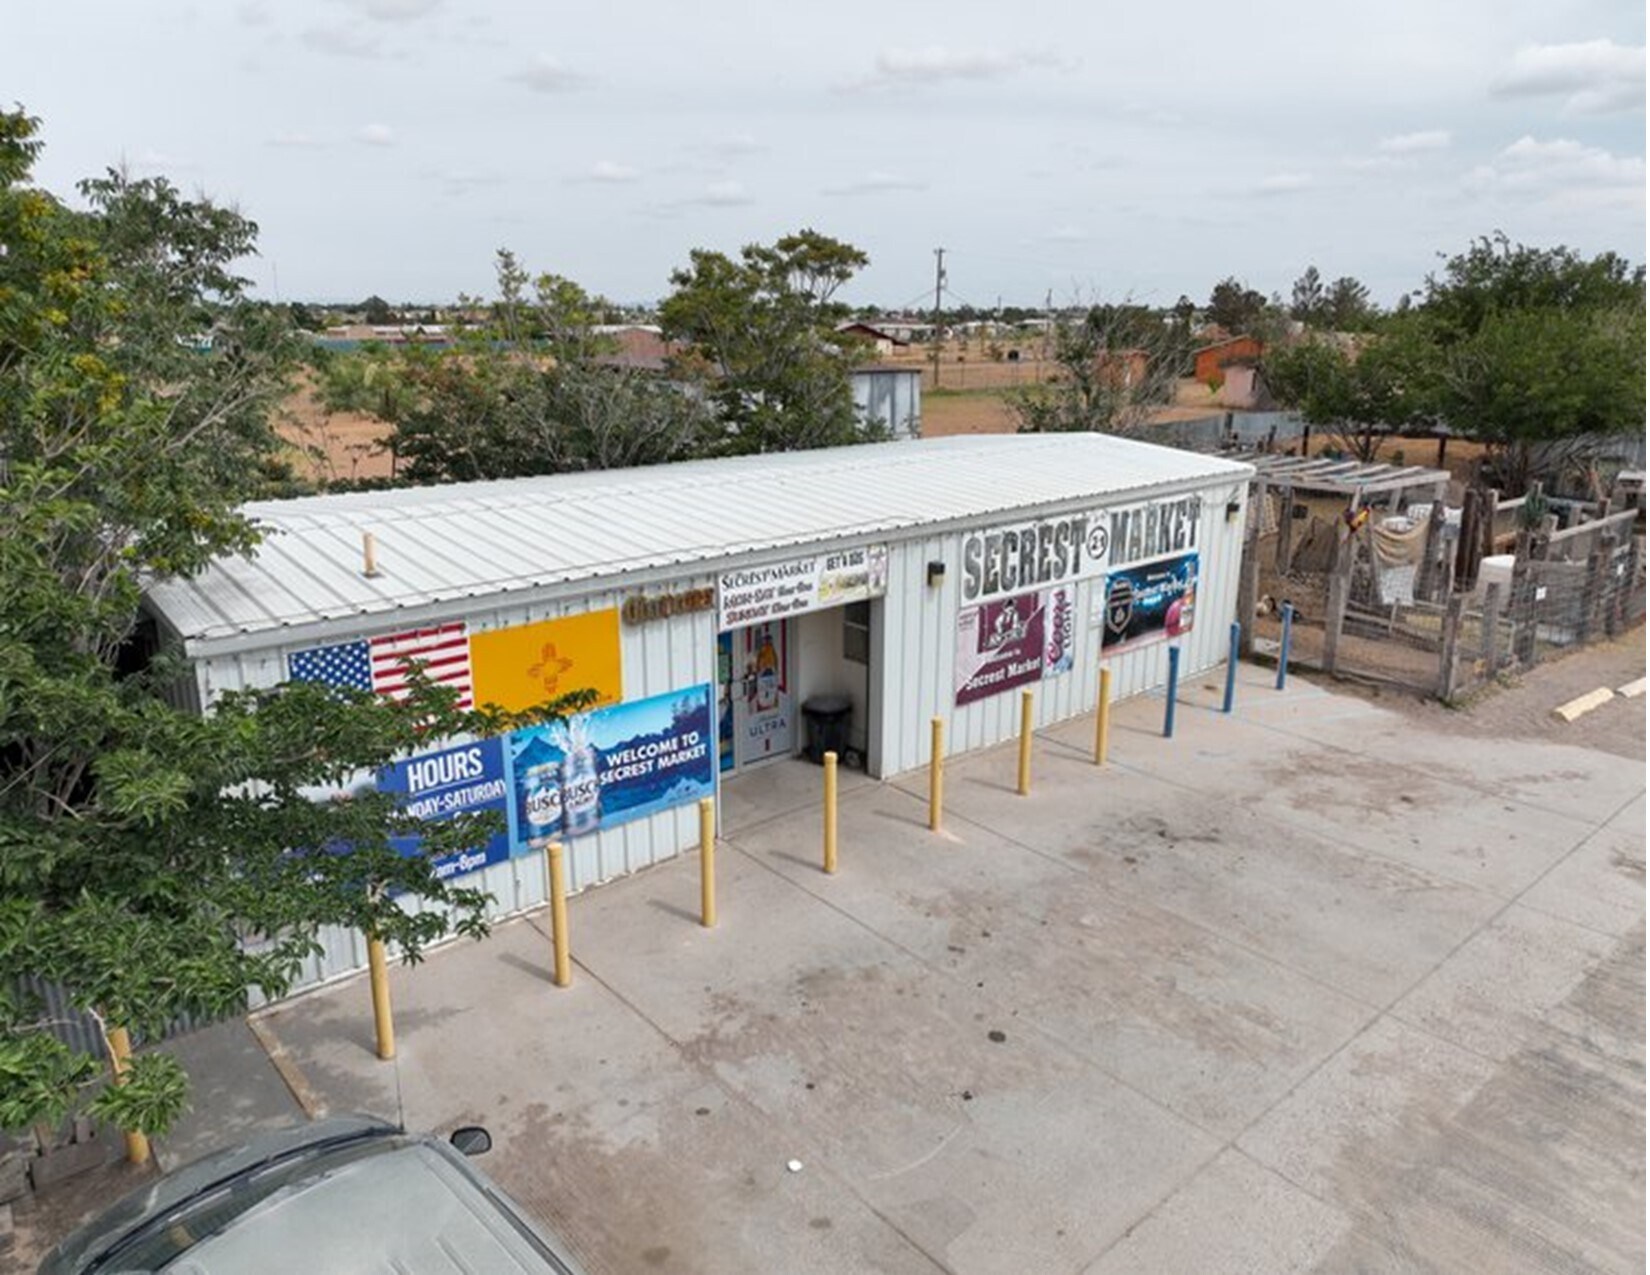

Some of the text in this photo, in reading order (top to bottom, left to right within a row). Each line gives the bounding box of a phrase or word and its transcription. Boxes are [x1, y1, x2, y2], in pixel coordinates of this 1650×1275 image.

[964, 518, 1088, 600] SECREST
[1109, 496, 1202, 566] MARKET
[771, 562, 814, 580] MARKET
[1063, 601, 1072, 649] LIGHT
[966, 668, 1005, 690] Secrest
[1007, 656, 1041, 678] Market
[749, 718, 786, 737] ULTRA
[407, 748, 483, 792] HOURS
[600, 743, 706, 785] SECREST MARKET
[606, 731, 699, 767] WELCOME TO
[397, 778, 506, 820] NDAY-SATURDAY
